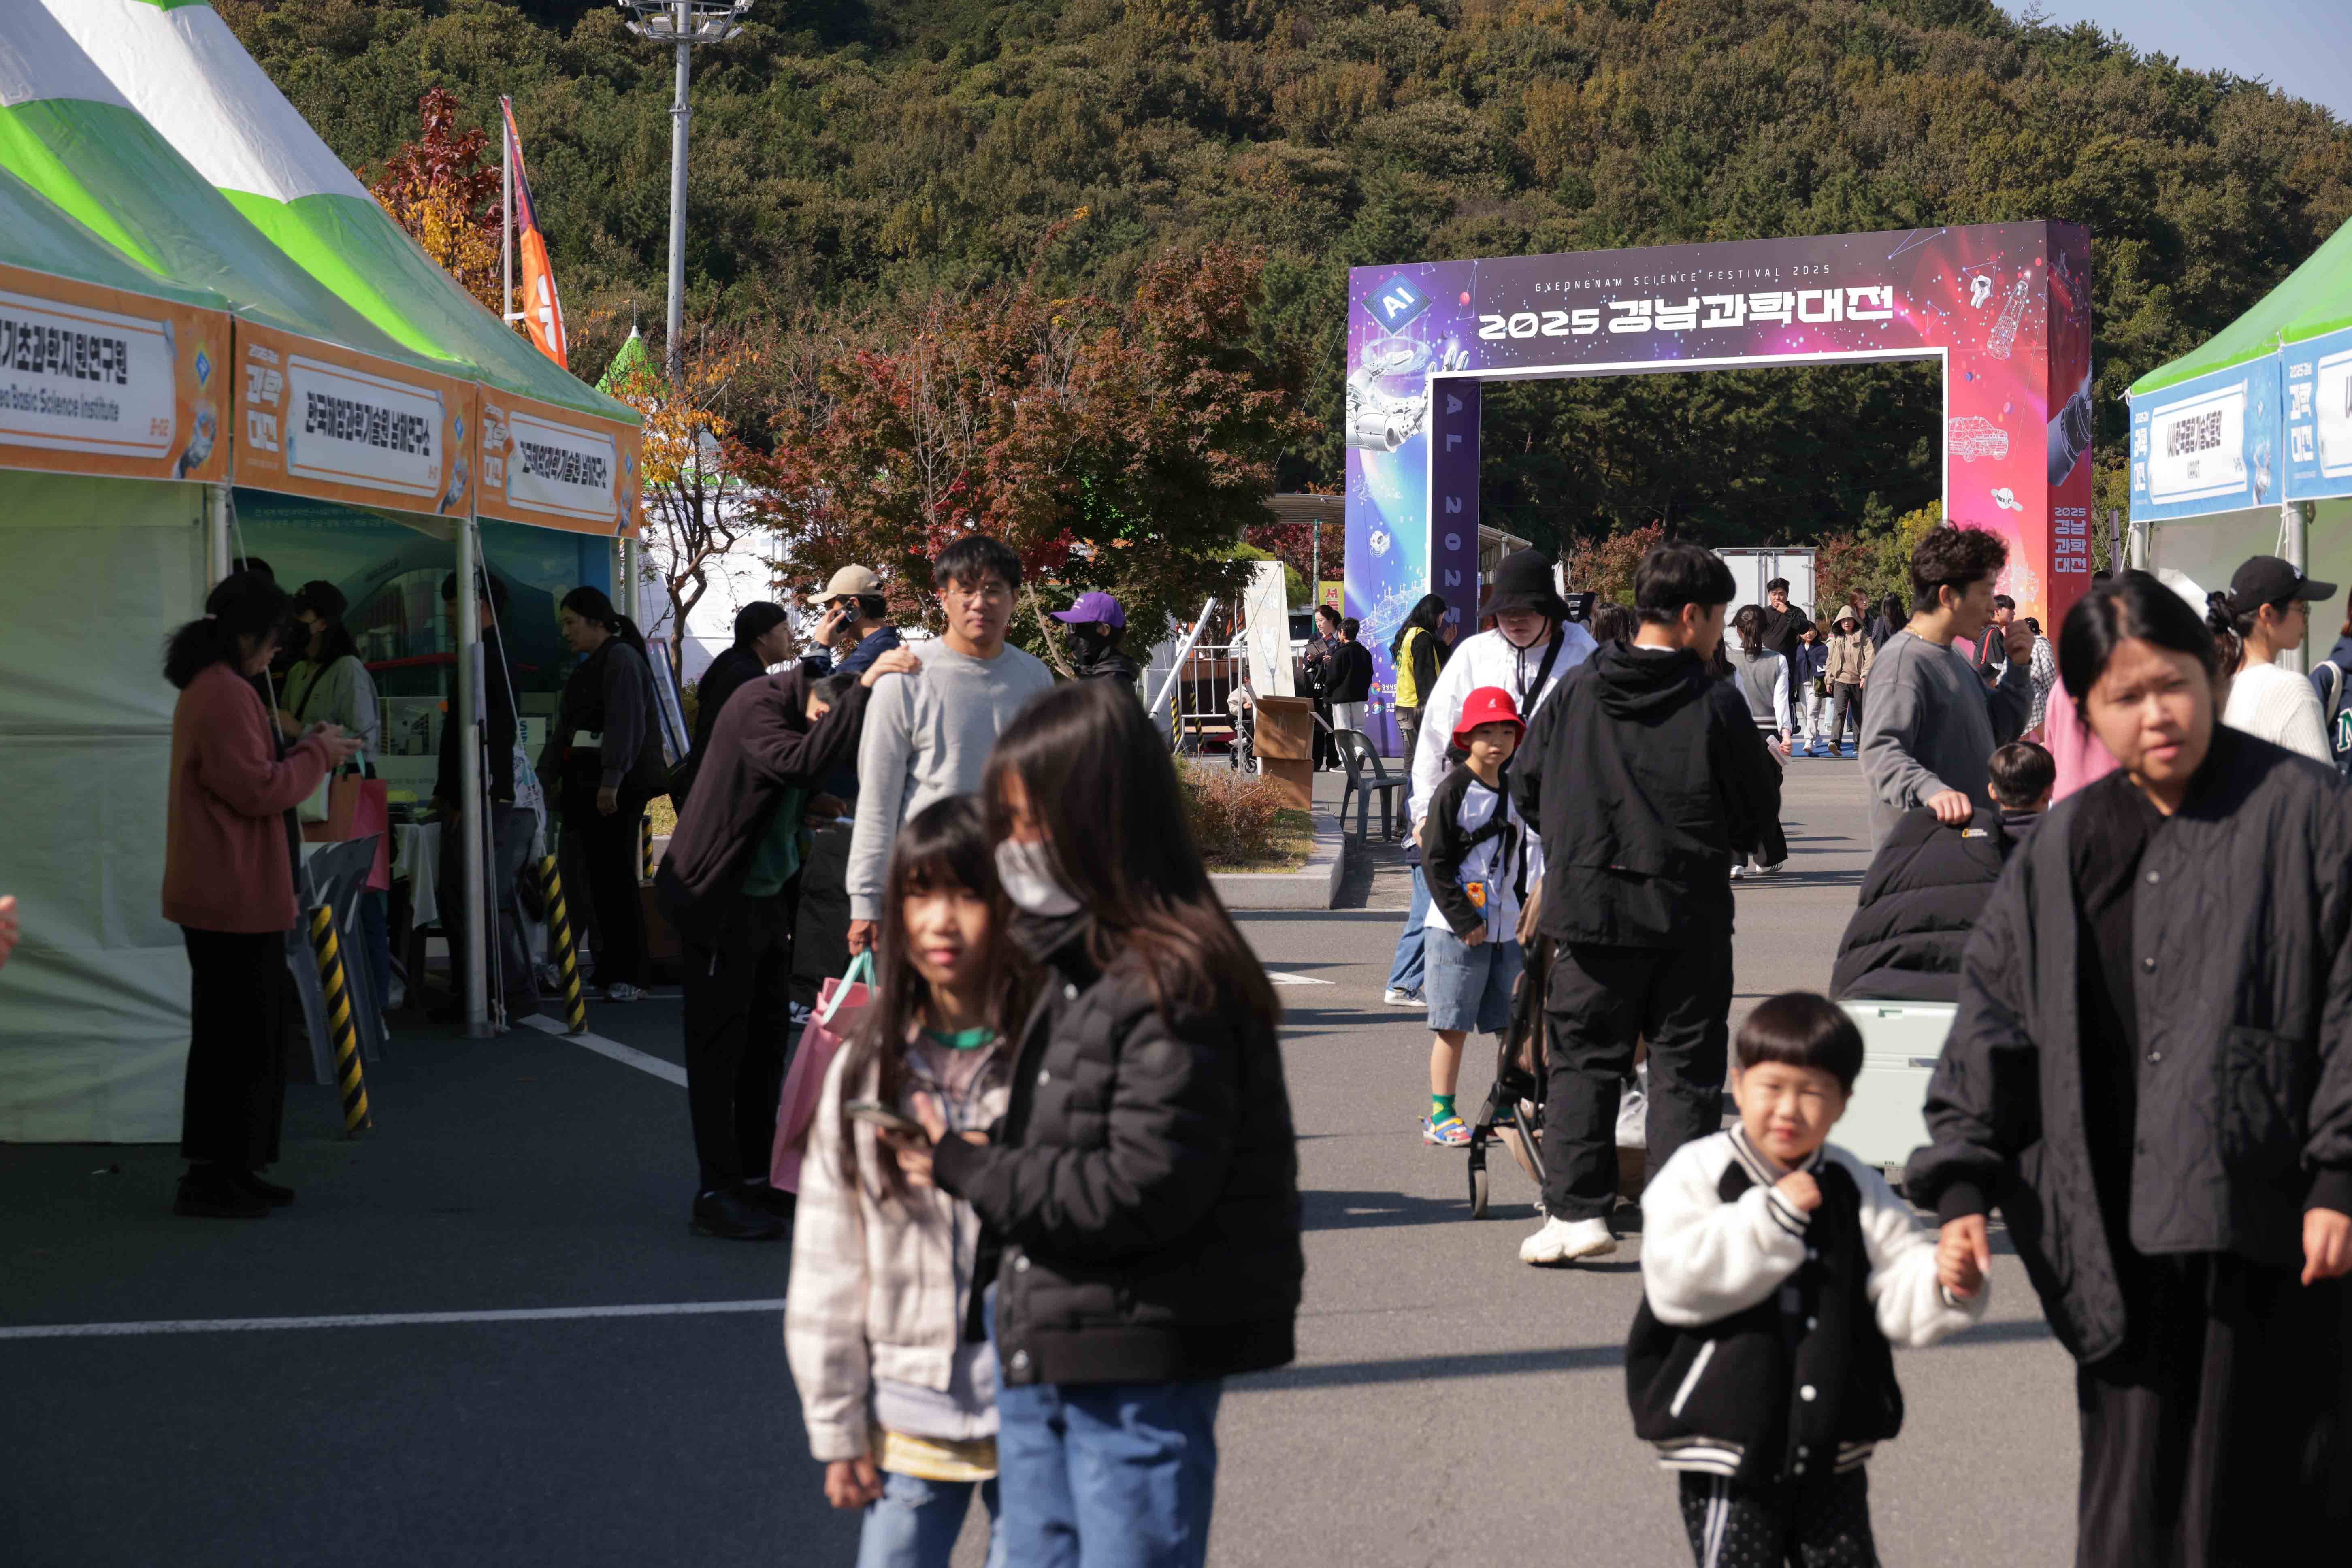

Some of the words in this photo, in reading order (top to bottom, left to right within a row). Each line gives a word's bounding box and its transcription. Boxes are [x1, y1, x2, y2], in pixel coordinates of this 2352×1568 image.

[1536, 278, 1622, 292] GYEONGNAM
[1634, 273, 1696, 285] SCIENCE
[1708, 268, 1780, 281] FESTIVAL
[1793, 265, 1829, 275] 2025
[1382, 286, 1415, 319] AI
[1479, 308, 1600, 340] 2025
[1608, 285, 1893, 334] 경남과학대전
[0, 319, 128, 385] 기초과학지원연구원
[2054, 507, 2086, 516] 2025
[2054, 520, 2086, 535] 경남
[2054, 538, 2086, 554] 과학
[2055, 557, 2086, 573] 대전
